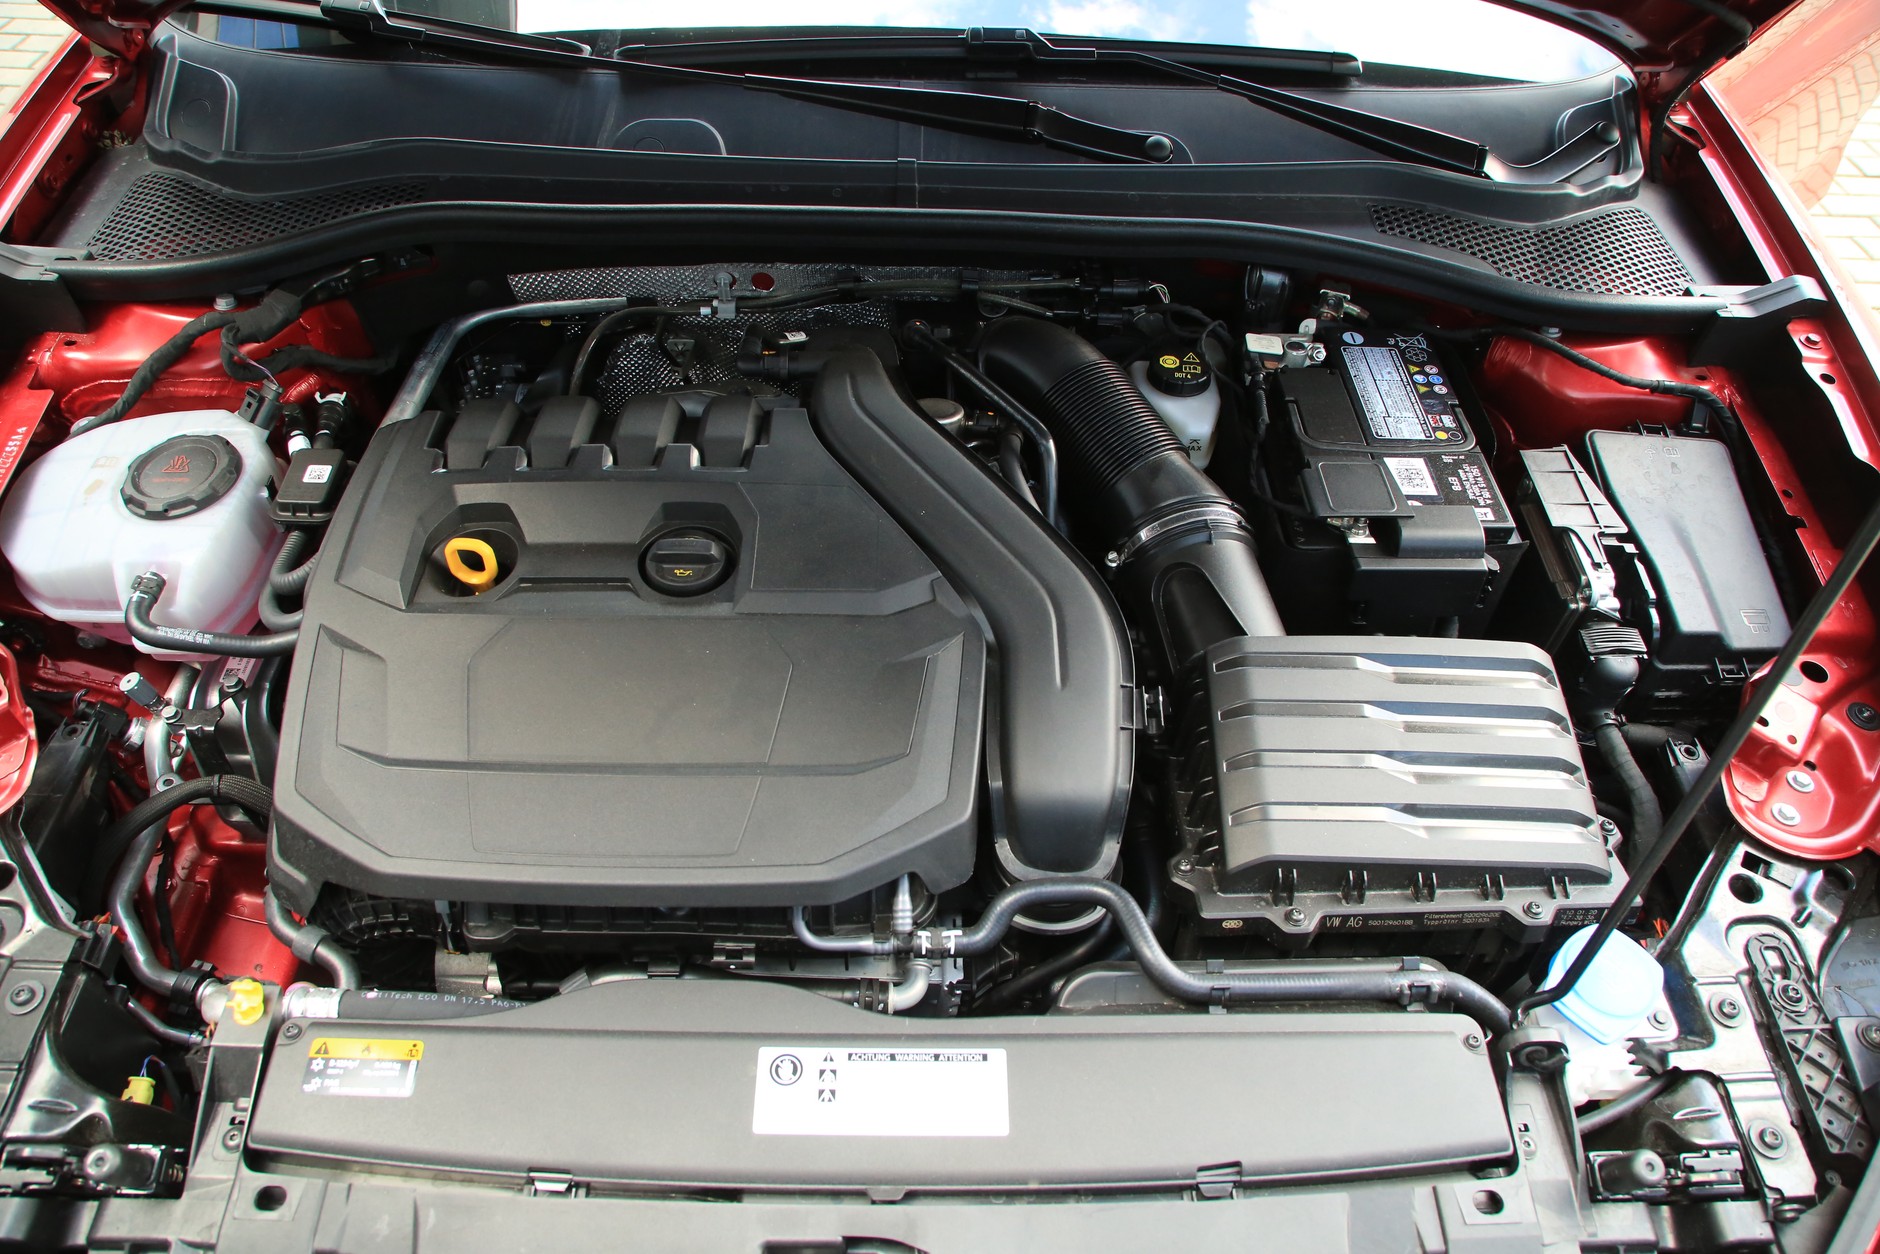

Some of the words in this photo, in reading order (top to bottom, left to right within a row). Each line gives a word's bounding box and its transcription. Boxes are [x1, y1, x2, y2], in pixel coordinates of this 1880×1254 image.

[1448, 476, 1462, 491] EFB
[1424, 912, 1463, 920] Filterelement
[1326, 917, 1345, 929] VW
[1346, 917, 1363, 928] AG
[418, 993, 438, 1001] ECO
[444, 994, 456, 1002] DN
[462, 996, 486, 1005] 17.5
[851, 1053, 891, 1062] ACHTUNG
[895, 1053, 935, 1062] WARNING
[938, 1054, 983, 1062] ATTENTION
